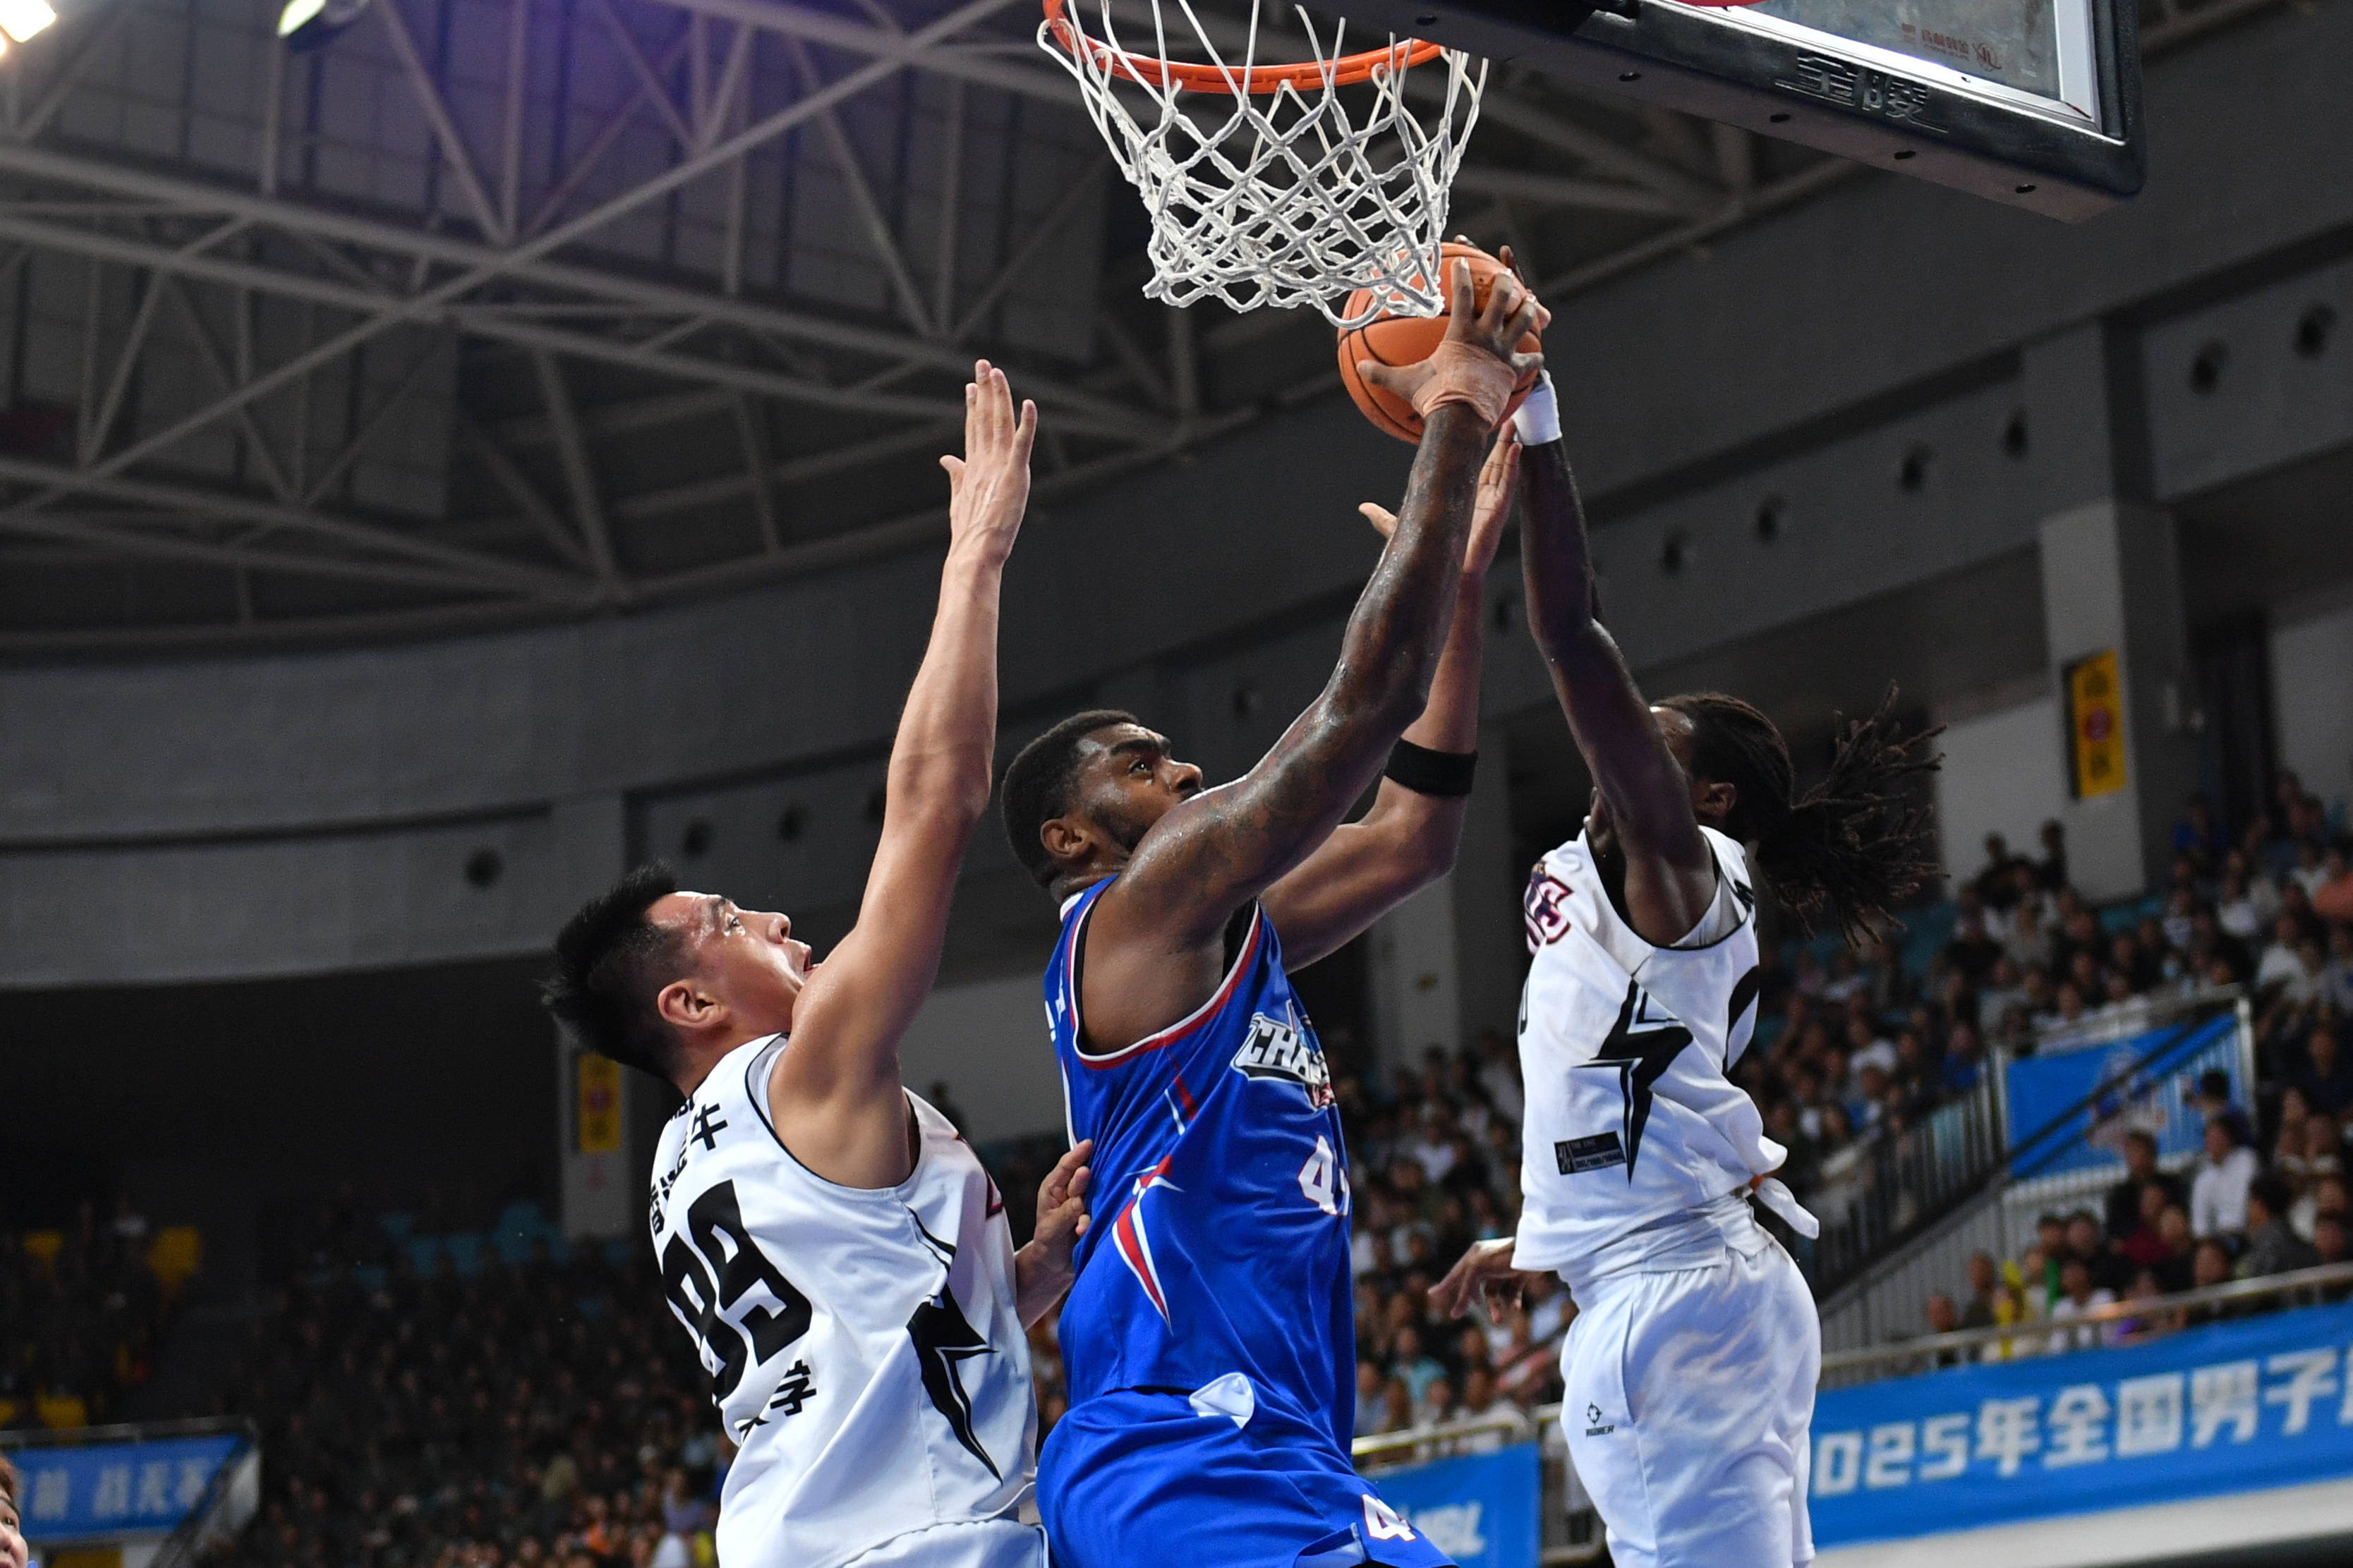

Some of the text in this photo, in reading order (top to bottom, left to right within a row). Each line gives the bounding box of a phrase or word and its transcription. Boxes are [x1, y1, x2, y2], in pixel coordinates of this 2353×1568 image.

[1812, 1342, 2353, 1498] 025年全国男子
